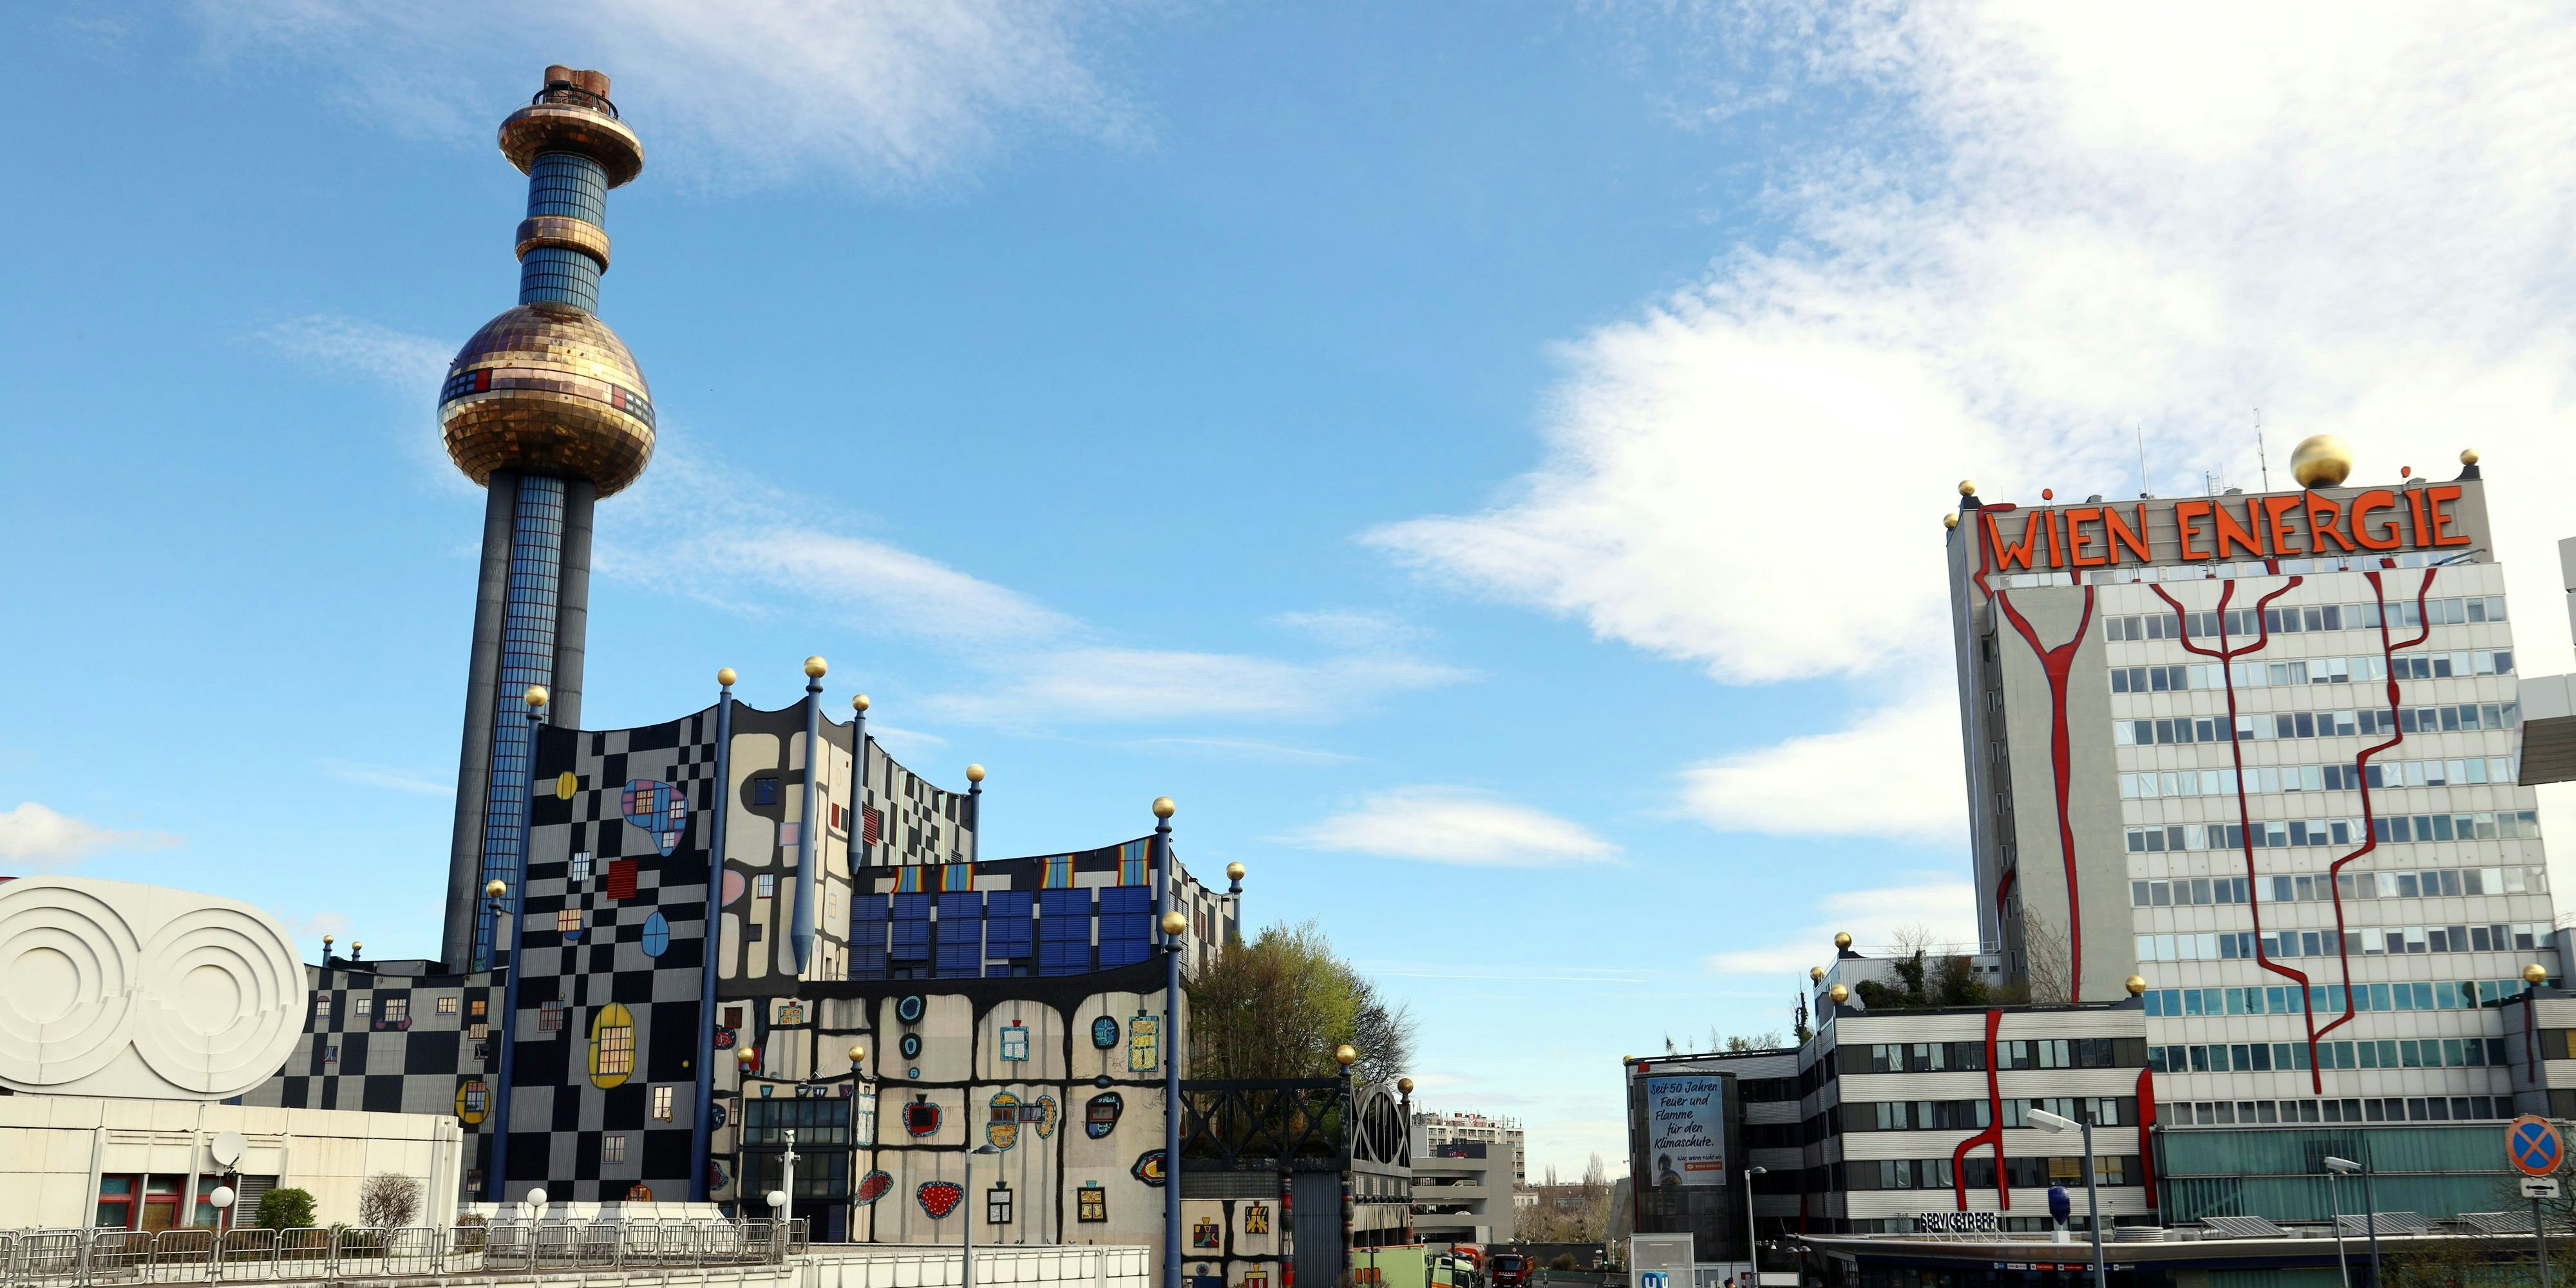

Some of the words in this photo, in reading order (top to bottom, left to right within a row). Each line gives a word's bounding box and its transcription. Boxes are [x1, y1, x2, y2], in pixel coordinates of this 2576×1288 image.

[1985, 502, 2152, 571] WIEN
[2175, 485, 2472, 561] ENERGIE
[1651, 1083, 1668, 1095] Seit
[1669, 1083, 1682, 1094] 50
[1685, 1080, 1717, 1094] Jahren
[1660, 1097, 1687, 1107] Feuer
[1689, 1094, 1710, 1106] und
[1656, 1109, 1693, 1121] Flamme
[1667, 1122, 1682, 1137] für
[1684, 1121, 1703, 1133] den
[1654, 1135, 1714, 1150] Klimaschutz.
[1920, 1212, 1995, 1229] SERVICETREFF
[1645, 1277, 1657, 1288] U
